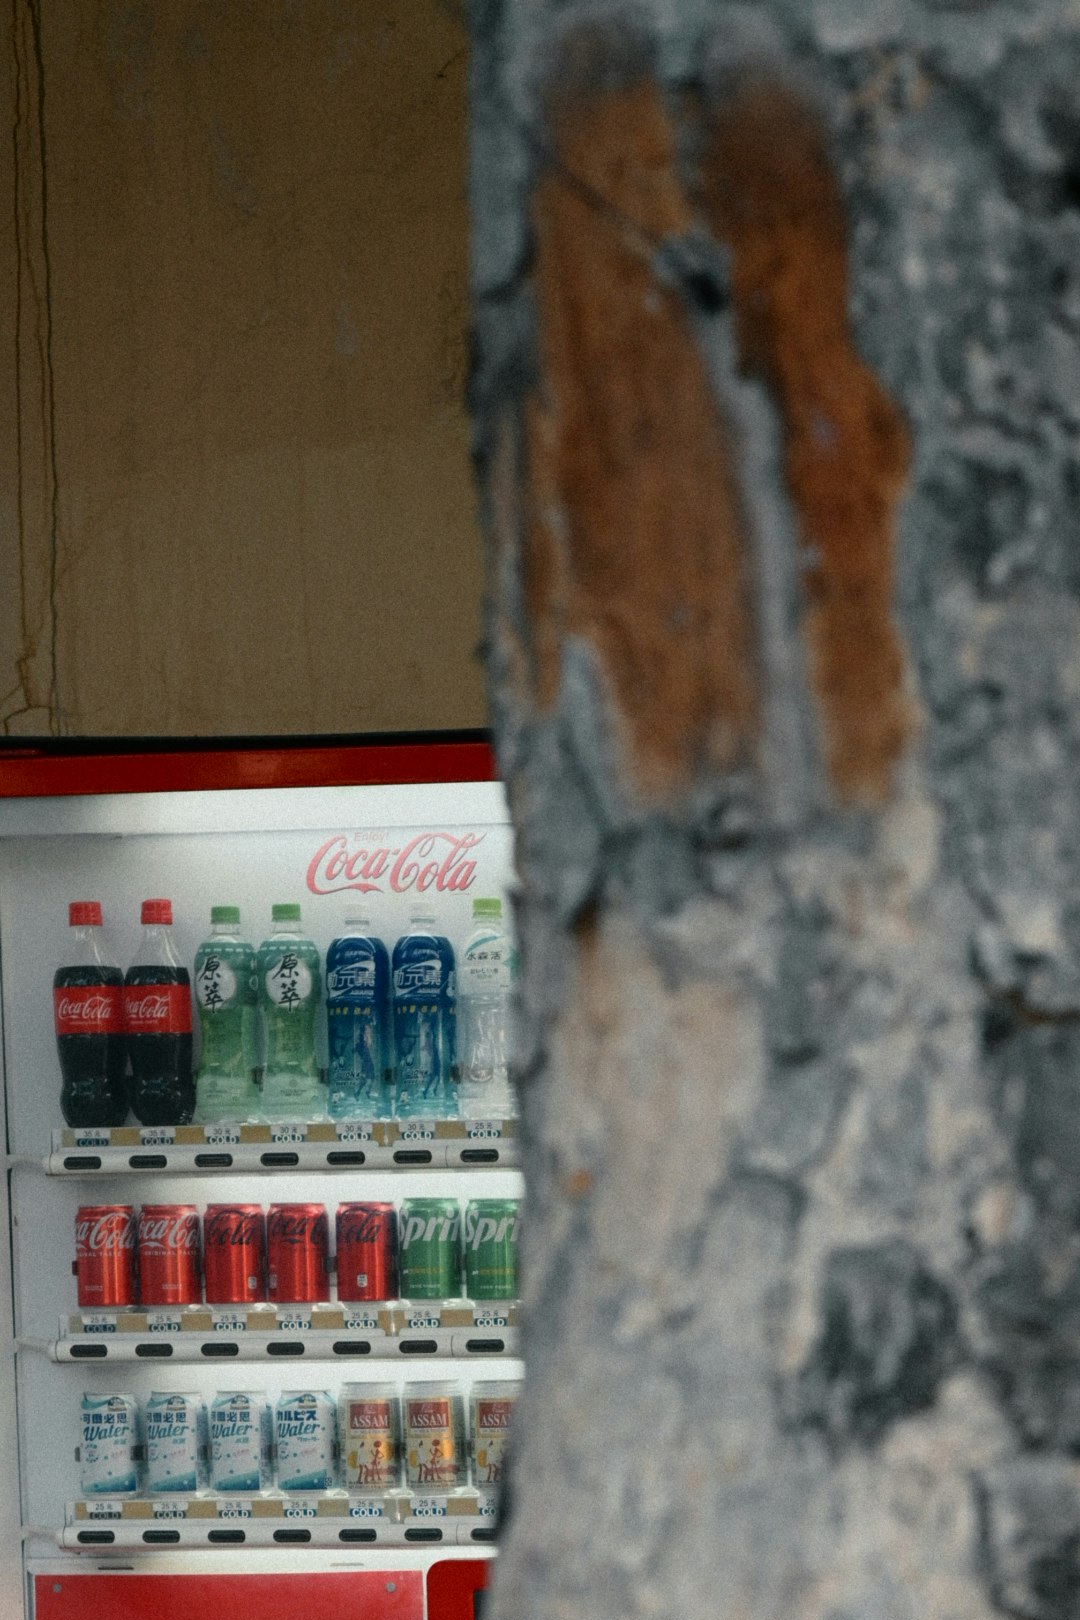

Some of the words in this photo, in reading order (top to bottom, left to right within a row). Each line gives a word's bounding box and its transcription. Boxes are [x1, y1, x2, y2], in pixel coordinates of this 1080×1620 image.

[354, 832, 389, 842] Enjoy!
[306, 832, 488, 895] Coca-Cola
[200, 954, 224, 1014] 原萃
[272, 952, 302, 1012] 原萃
[58, 995, 112, 1020] Coca-Cola
[404, 1132, 432, 1140] COLD
[470, 1130, 499, 1138] COLD
[144, 1137, 172, 1145] COLD
[210, 1136, 237, 1144] COLD
[216, 1323, 243, 1331] COLD
[282, 1321, 309, 1330] COLD
[348, 1320, 375, 1329] COLD
[410, 1319, 438, 1328] COLD
[477, 1318, 504, 1327] COLD
[151, 1324, 178, 1332] COLD
[352, 1414, 389, 1428] ASSAM
[412, 1413, 448, 1427] ASSAM
[83, 1422, 130, 1442] Water
[148, 1422, 189, 1440] Water
[211, 1422, 252, 1440] Water
[278, 1421, 321, 1440] Water
[156, 1511, 185, 1519] COLD
[221, 1510, 249, 1518] COLD
[416, 1508, 444, 1516] COLD
